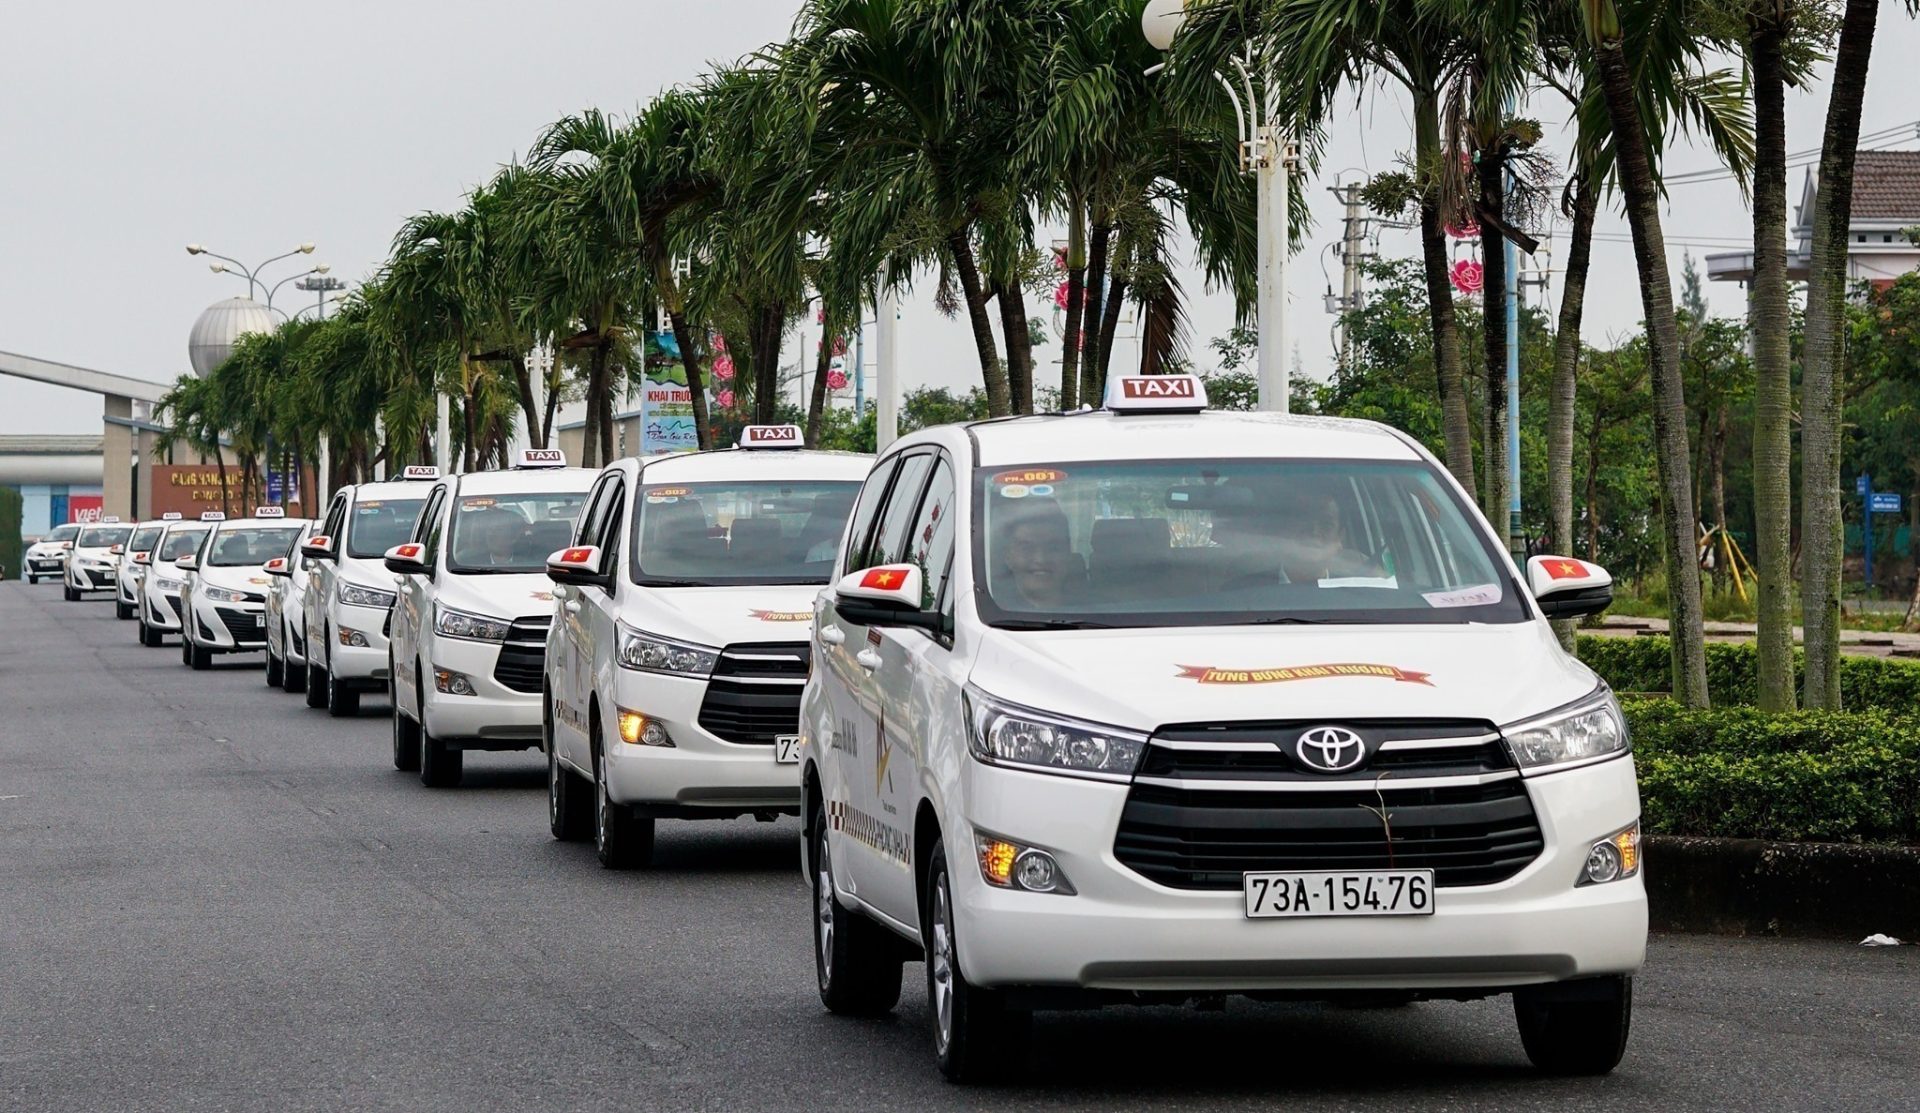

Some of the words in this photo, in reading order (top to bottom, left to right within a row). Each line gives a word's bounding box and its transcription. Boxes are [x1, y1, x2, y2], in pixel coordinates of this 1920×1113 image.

[1128, 380, 1190, 395] TAXI
[648, 391, 668, 401] KHAI
[753, 428, 793, 439] TAXI
[527, 451, 559, 460] TAXI
[1252, 876, 1427, 912] 73A-154.76
